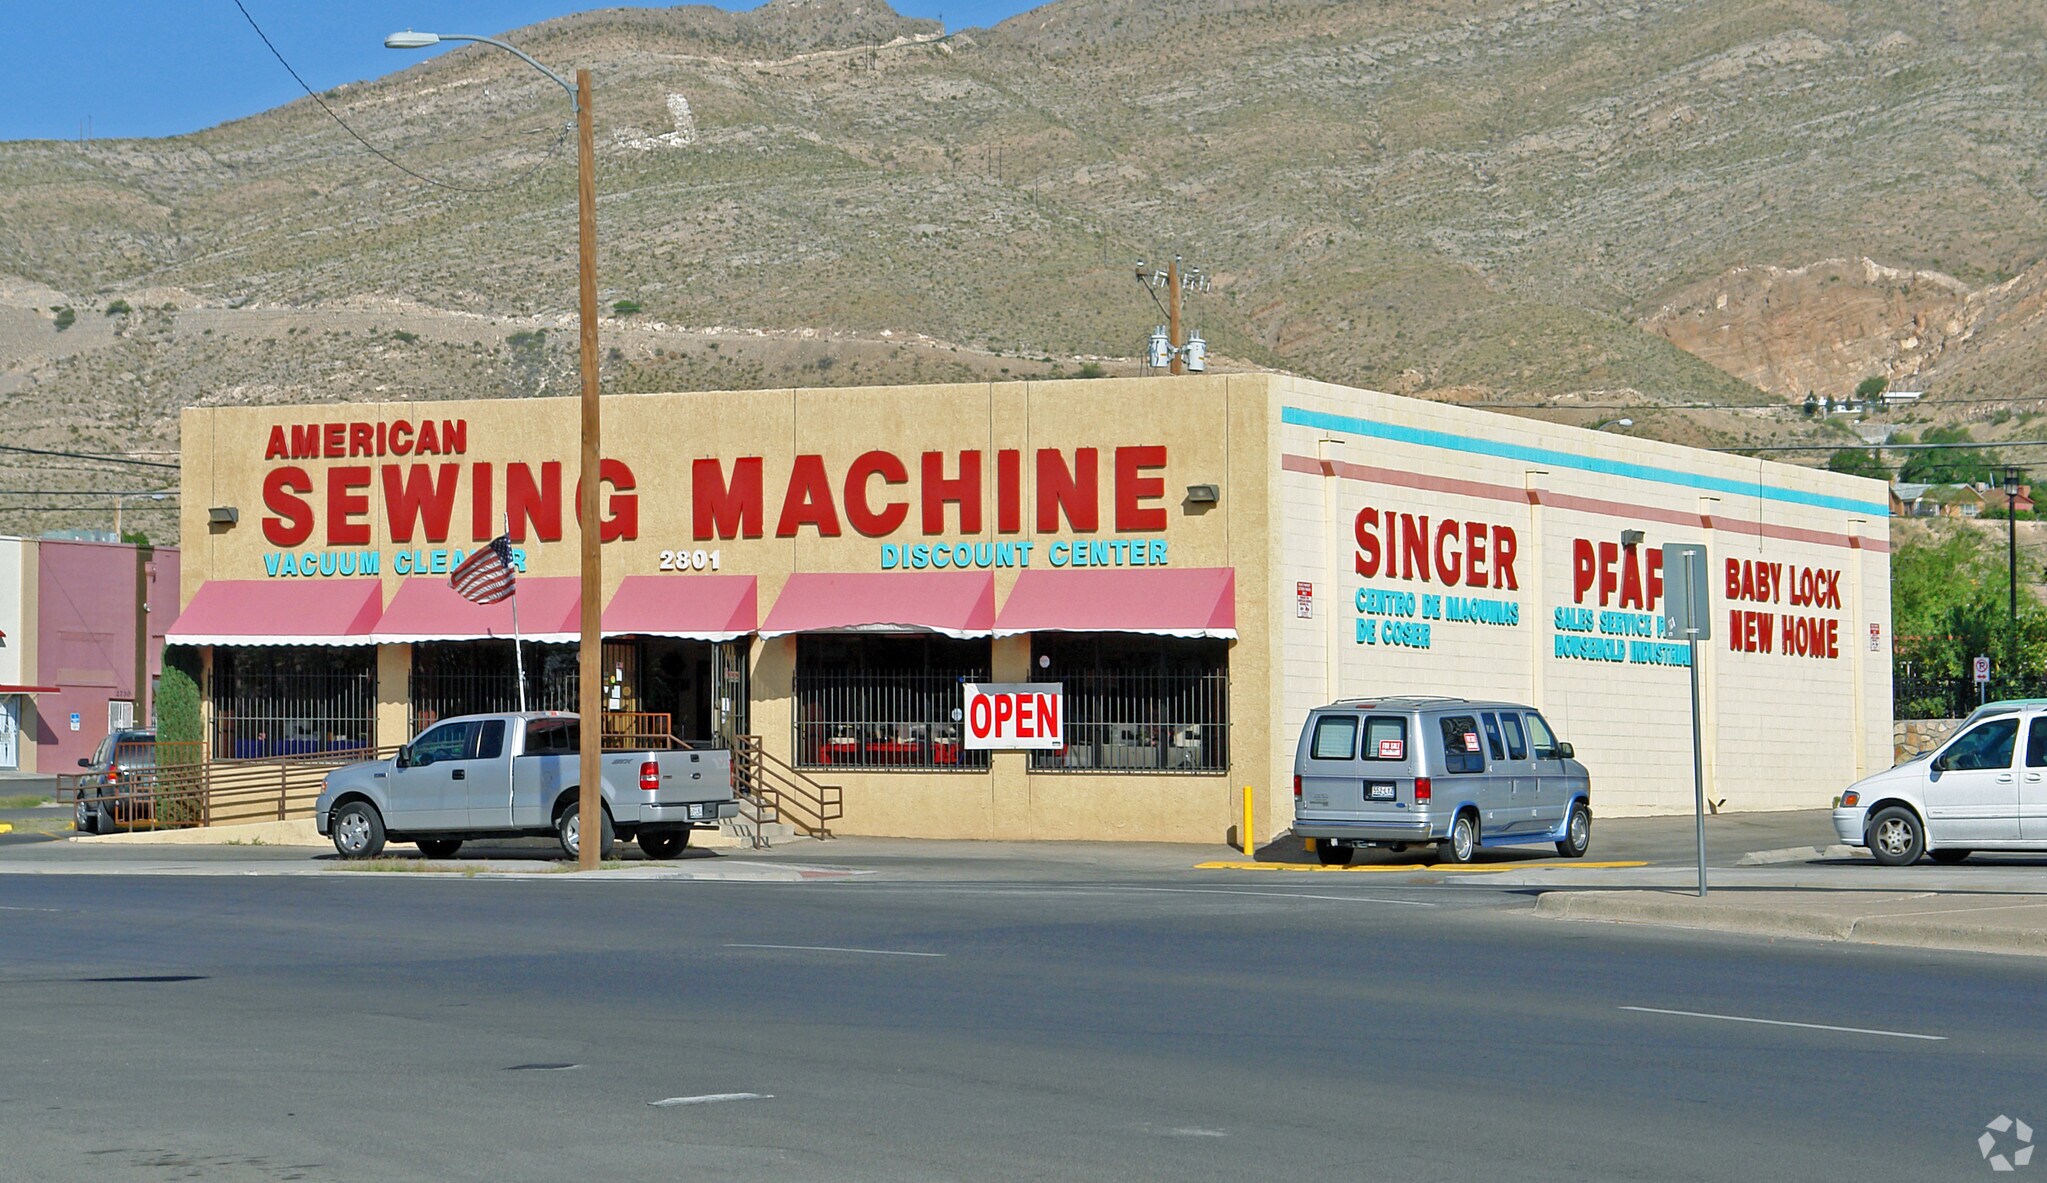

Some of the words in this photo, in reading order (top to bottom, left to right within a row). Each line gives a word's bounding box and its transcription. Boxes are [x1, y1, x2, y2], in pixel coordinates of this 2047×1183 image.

[265, 419, 467, 459] AMERICAN
[262, 455, 639, 546] SEWING
[692, 445, 1168, 540] MACHINE
[264, 551, 380, 577] VACUUM
[394, 548, 527, 575] CLEAR
[659, 549, 720, 570] 2801
[881, 540, 1034, 569] DISCOUNT
[1049, 539, 1168, 566] CENTER
[1354, 506, 1518, 591] SINGER
[1573, 538, 1664, 611] PFAF
[1725, 557, 1783, 604] BABY
[1789, 565, 1842, 610] LOCK
[1355, 587, 1416, 616] CENTRO
[1422, 594, 1442, 620] DE
[1445, 596, 1520, 626] MAQUINAS
[1554, 606, 1595, 632] SALES
[1599, 610, 1652, 636] SERVICE
[1356, 618, 1377, 644] DE
[1381, 620, 1431, 648] COSER
[1554, 634, 1626, 662] HOUSEHOLD
[1729, 609, 1774, 654] NEW
[1781, 614, 1839, 659] HOME
[970, 693, 1058, 739] OPEN
